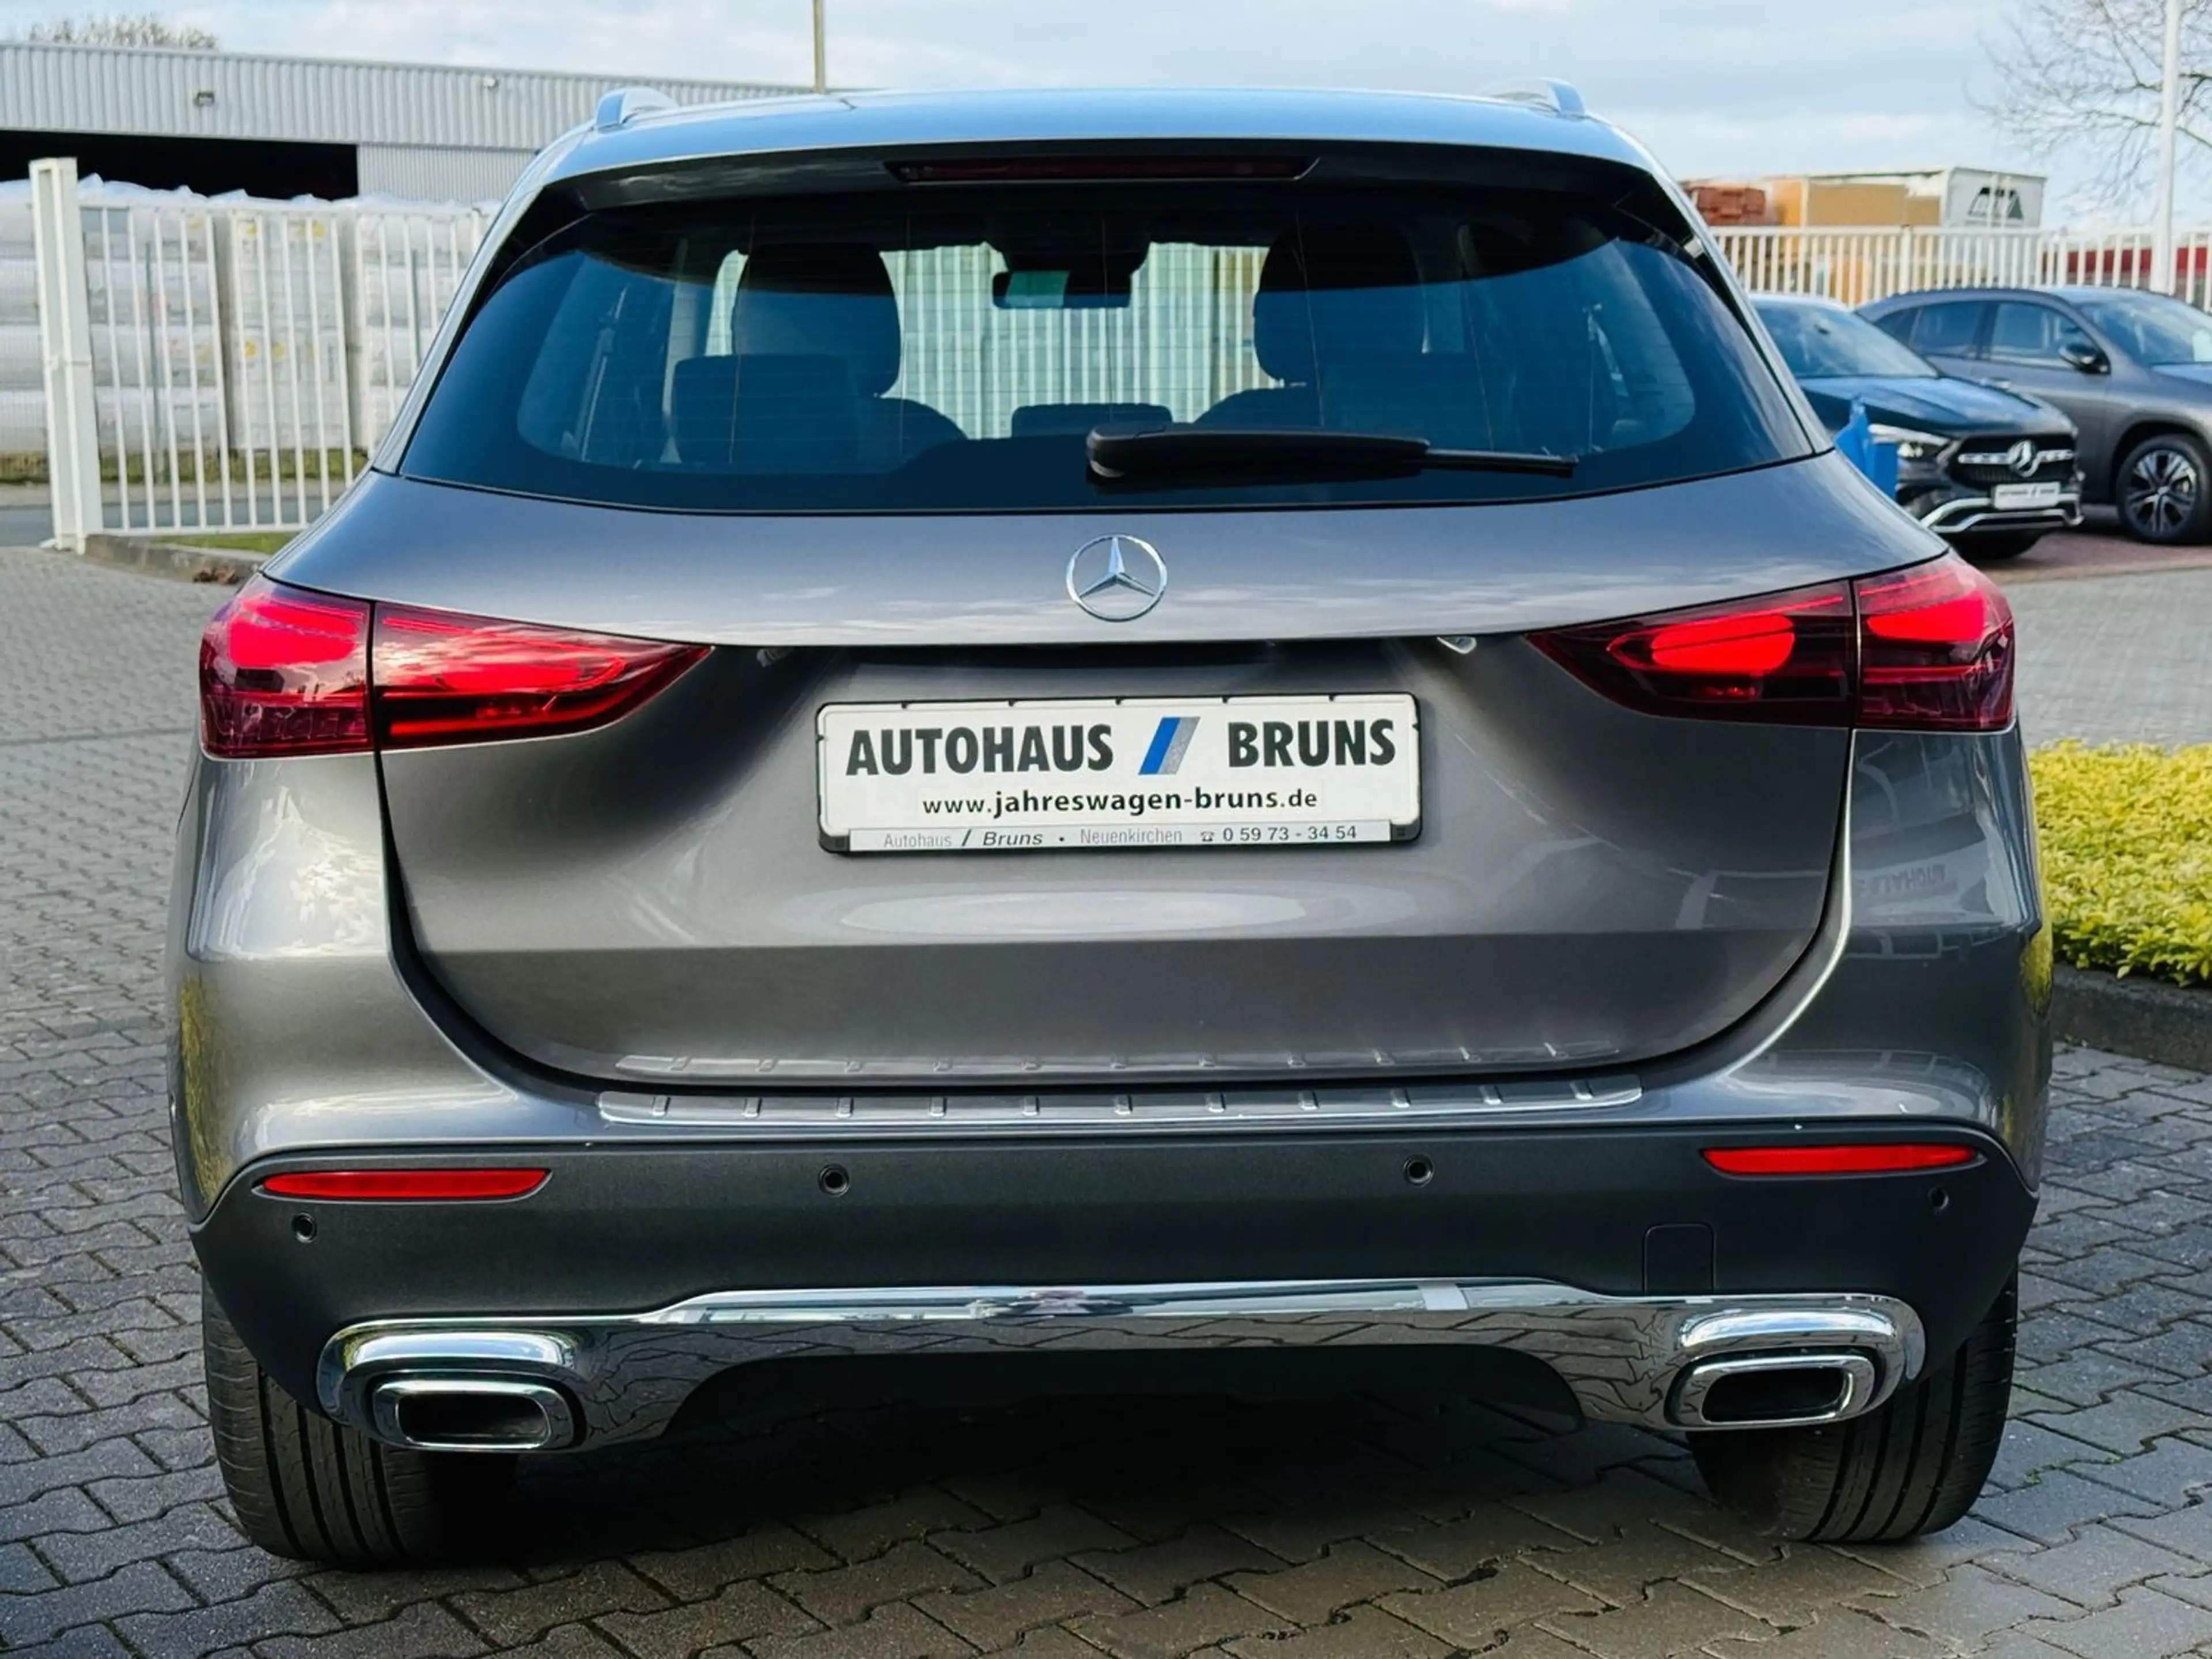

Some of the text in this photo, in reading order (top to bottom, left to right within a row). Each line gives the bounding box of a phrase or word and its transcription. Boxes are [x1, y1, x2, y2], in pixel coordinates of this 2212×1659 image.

[846, 718, 1396, 775] AUTOHAUS BRUNS
[923, 787, 1317, 819] www.jahreswagen-bruns.de
[884, 833, 952, 847] Autohaus
[983, 831, 1043, 846] Bruns
[1080, 828, 1183, 844] Neuenkirchen
